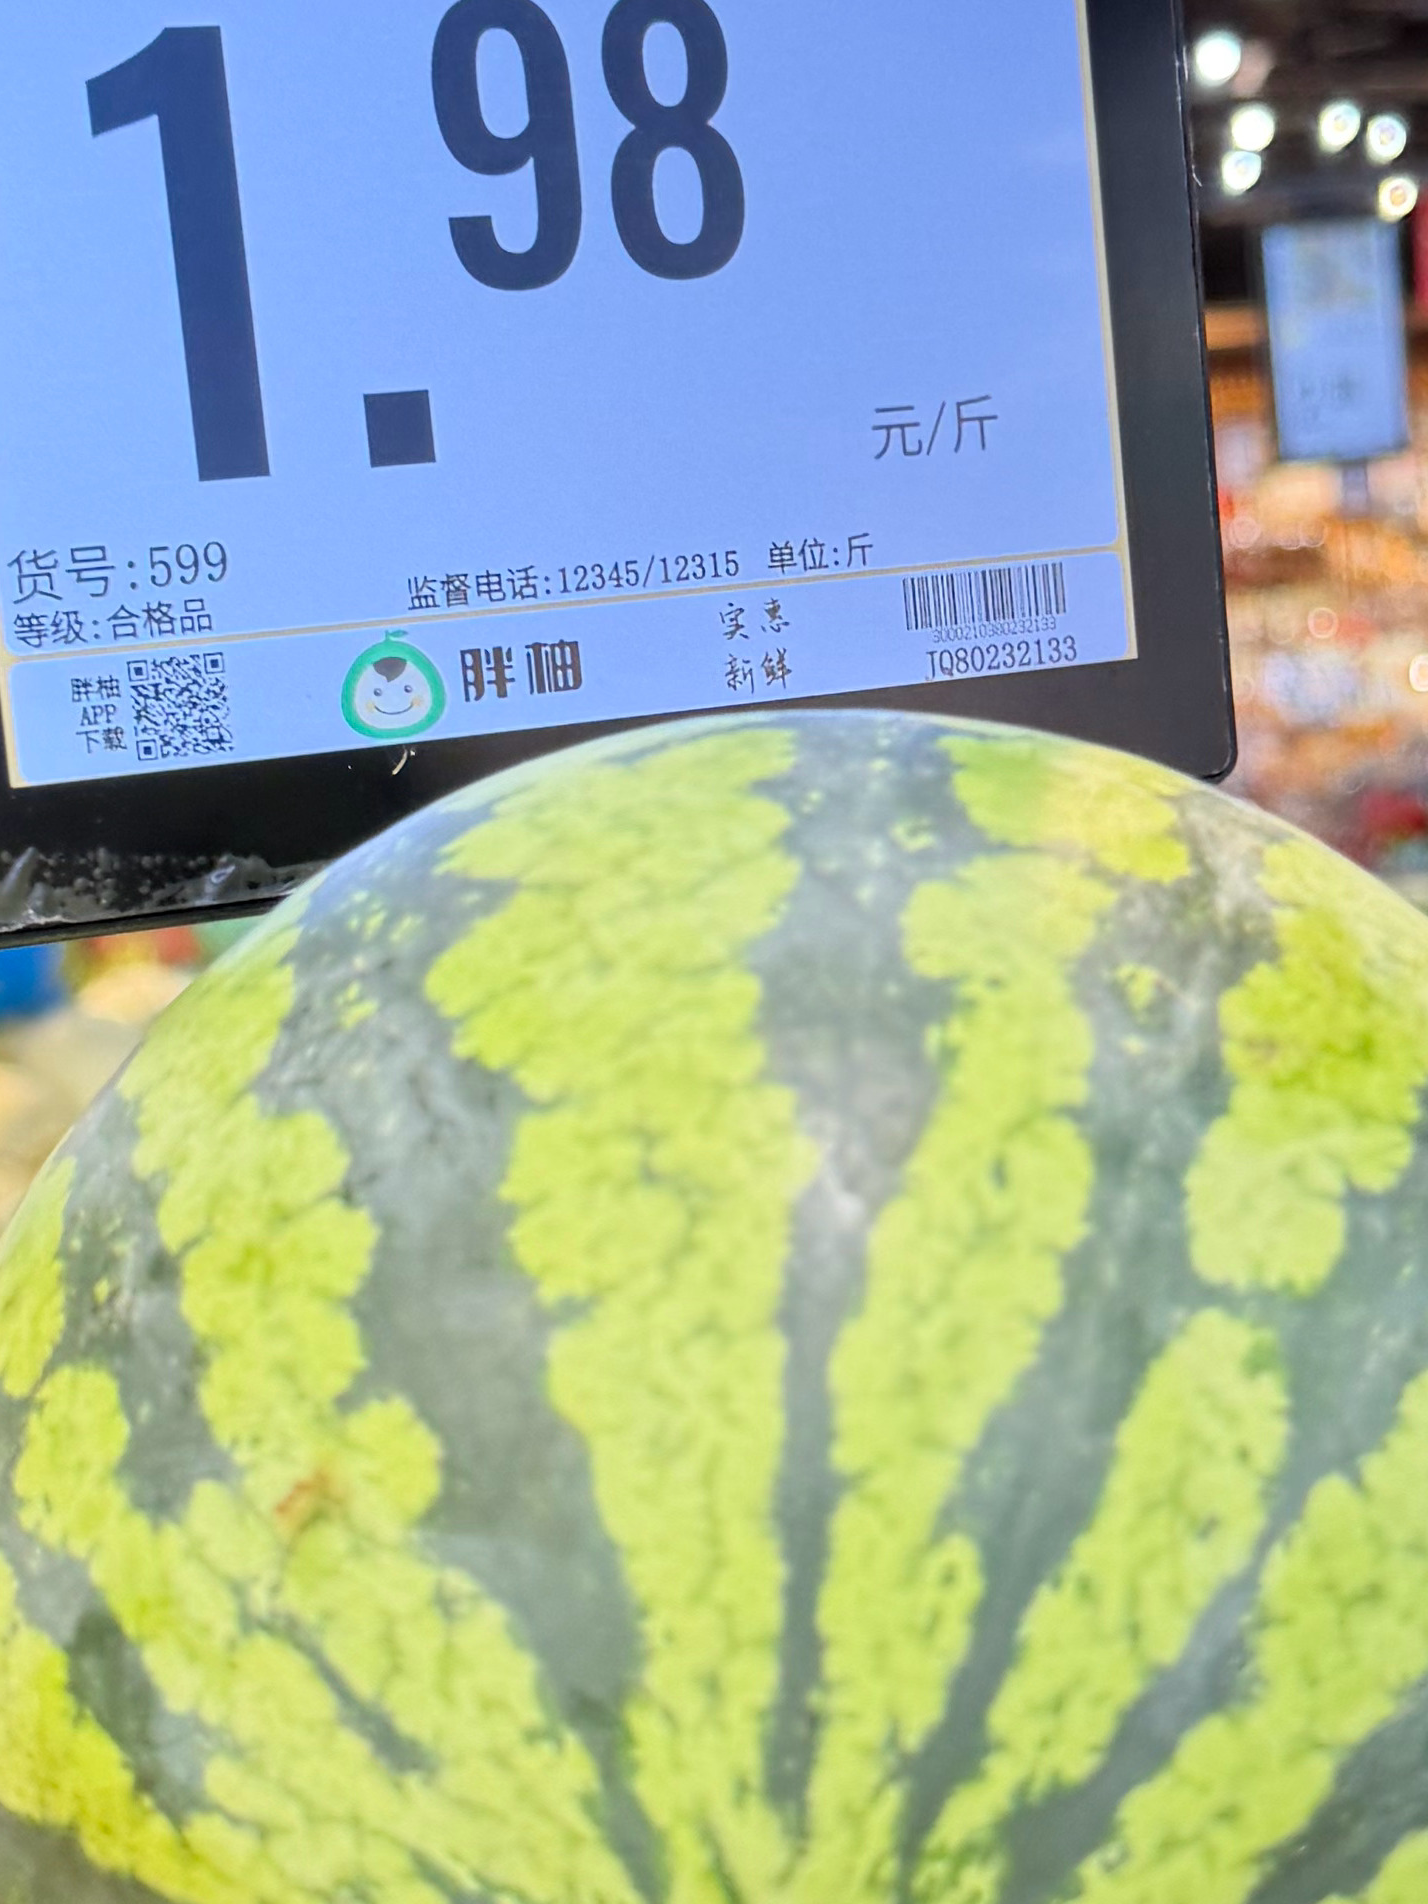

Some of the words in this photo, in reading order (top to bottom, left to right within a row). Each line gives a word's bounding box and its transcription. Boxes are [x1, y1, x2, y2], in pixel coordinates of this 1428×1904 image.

[871, 394, 999, 460] 元/斤
[7, 540, 229, 605] 货号:599
[407, 549, 740, 611] 监督电话:12345/12315
[767, 533, 873, 575] 单位:斤
[12, 598, 214, 649] 等级:合格品
[459, 638, 584, 703] 胖柚
[925, 634, 1078, 682] JQ80232133
[75, 725, 127, 754] 下载
[80, 703, 117, 726] APP
